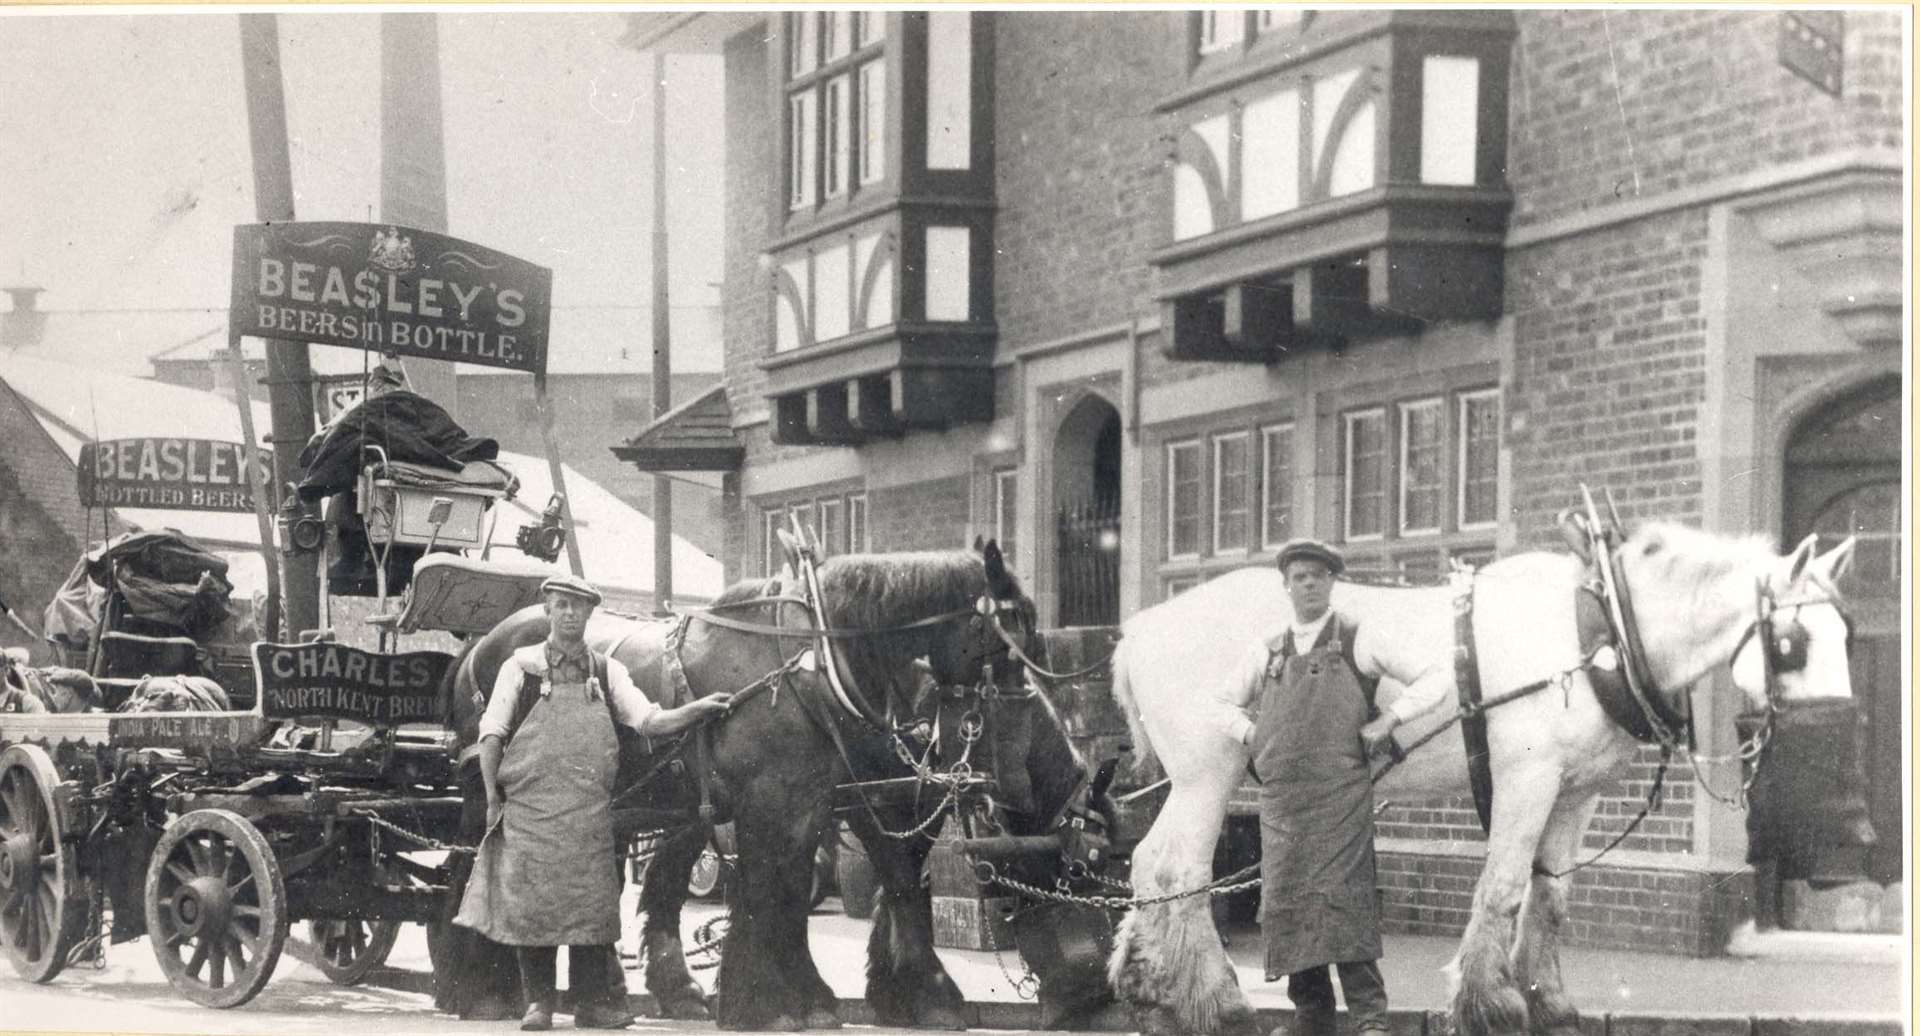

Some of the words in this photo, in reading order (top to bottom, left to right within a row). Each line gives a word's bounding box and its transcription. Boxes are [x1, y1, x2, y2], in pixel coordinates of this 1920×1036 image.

[258, 258, 527, 328] BEASLEY'S
[258, 304, 359, 341] BEERS
[95, 484, 184, 506] BOTTLED
[271, 646, 430, 688] CHARLES
[269, 687, 331, 710] NORTH
[336, 687, 383, 718] KENT
[151, 718, 181, 737] PALE
[190, 718, 212, 737] ALE
